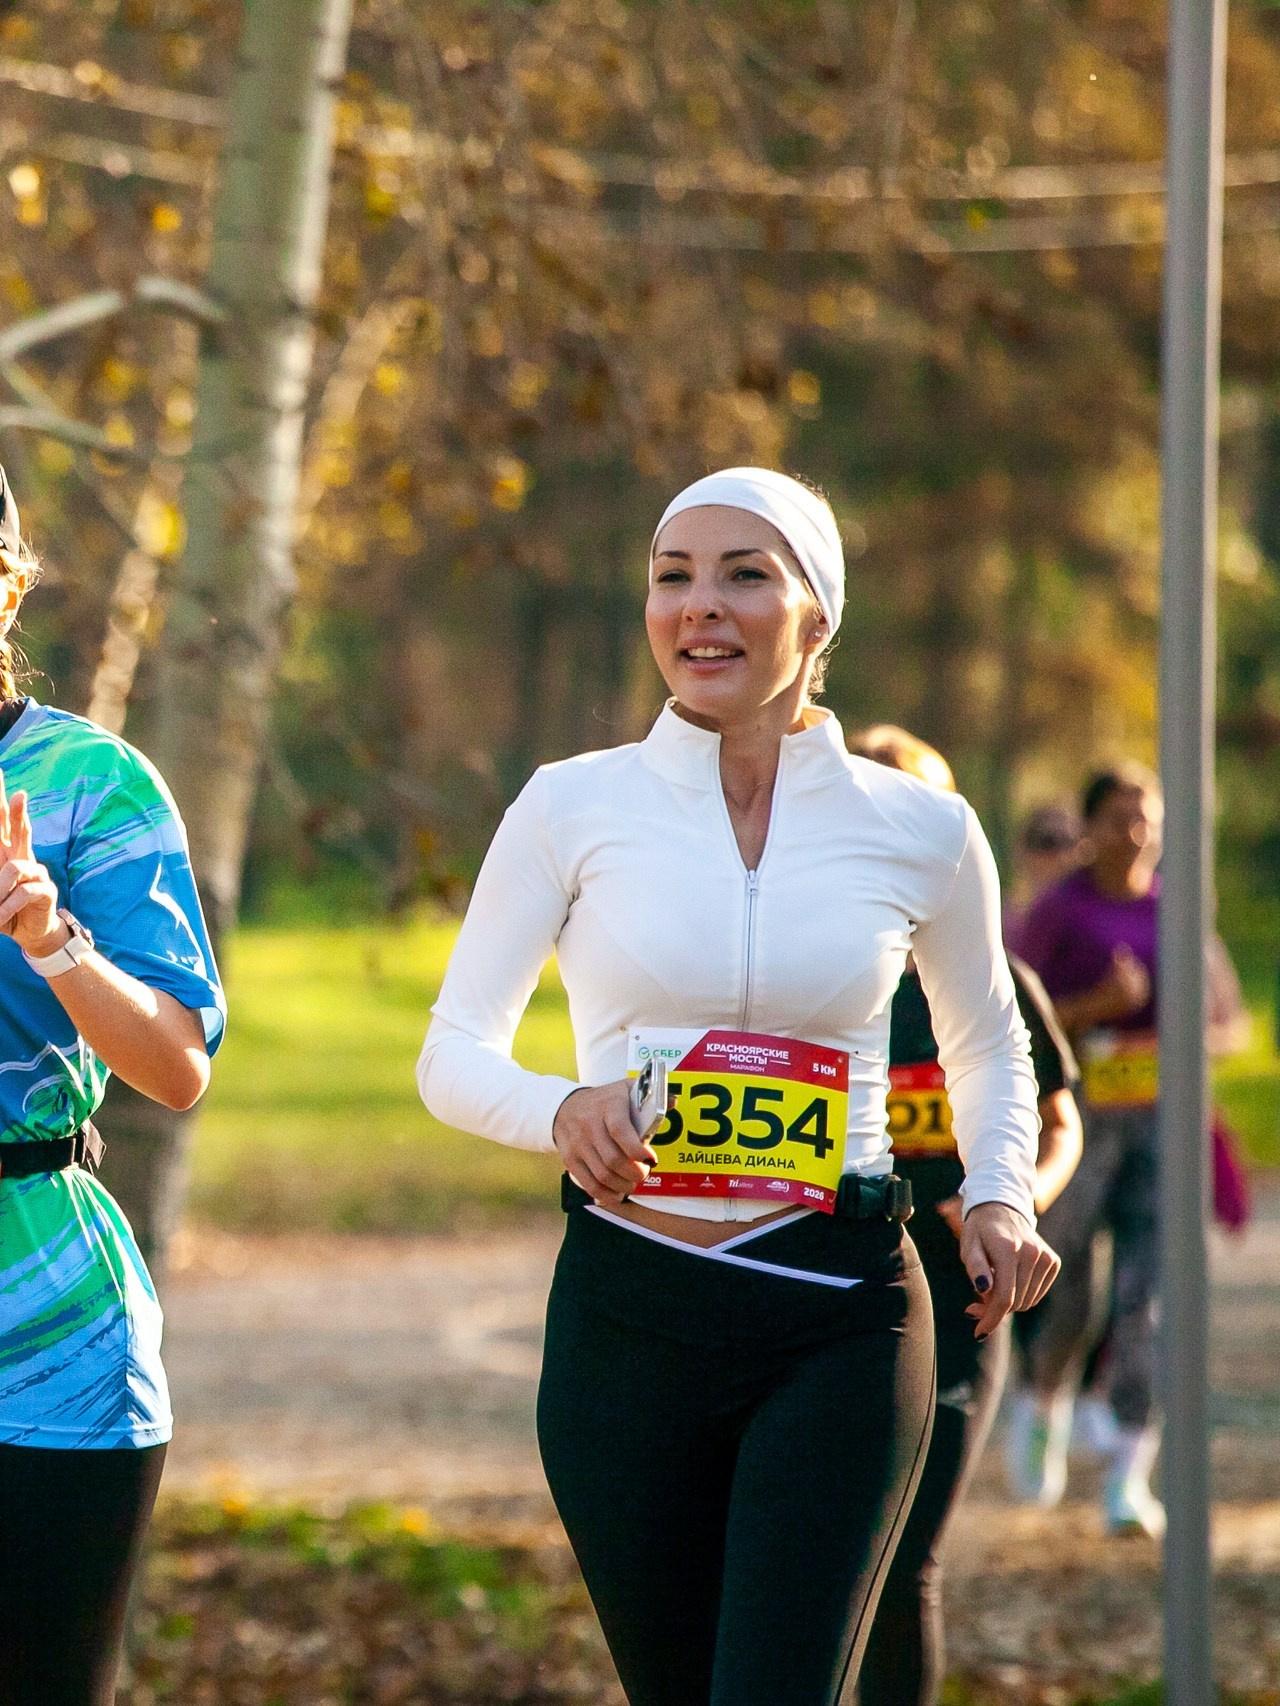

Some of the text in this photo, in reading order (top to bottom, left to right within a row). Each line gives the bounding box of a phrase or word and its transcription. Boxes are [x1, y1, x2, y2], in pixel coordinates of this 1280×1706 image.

[652, 1049, 682, 1059] СБЕР
[706, 1043, 789, 1060] КРАСНОЯРСКИЕ
[728, 1053, 768, 1065] МОСТЫ
[729, 1063, 766, 1072] МАРАФОН
[812, 1062, 820, 1073] 5
[678, 1150, 796, 1170] ЗАЙЦЕВА ДИАНА
[803, 1186, 825, 1201] 2026
